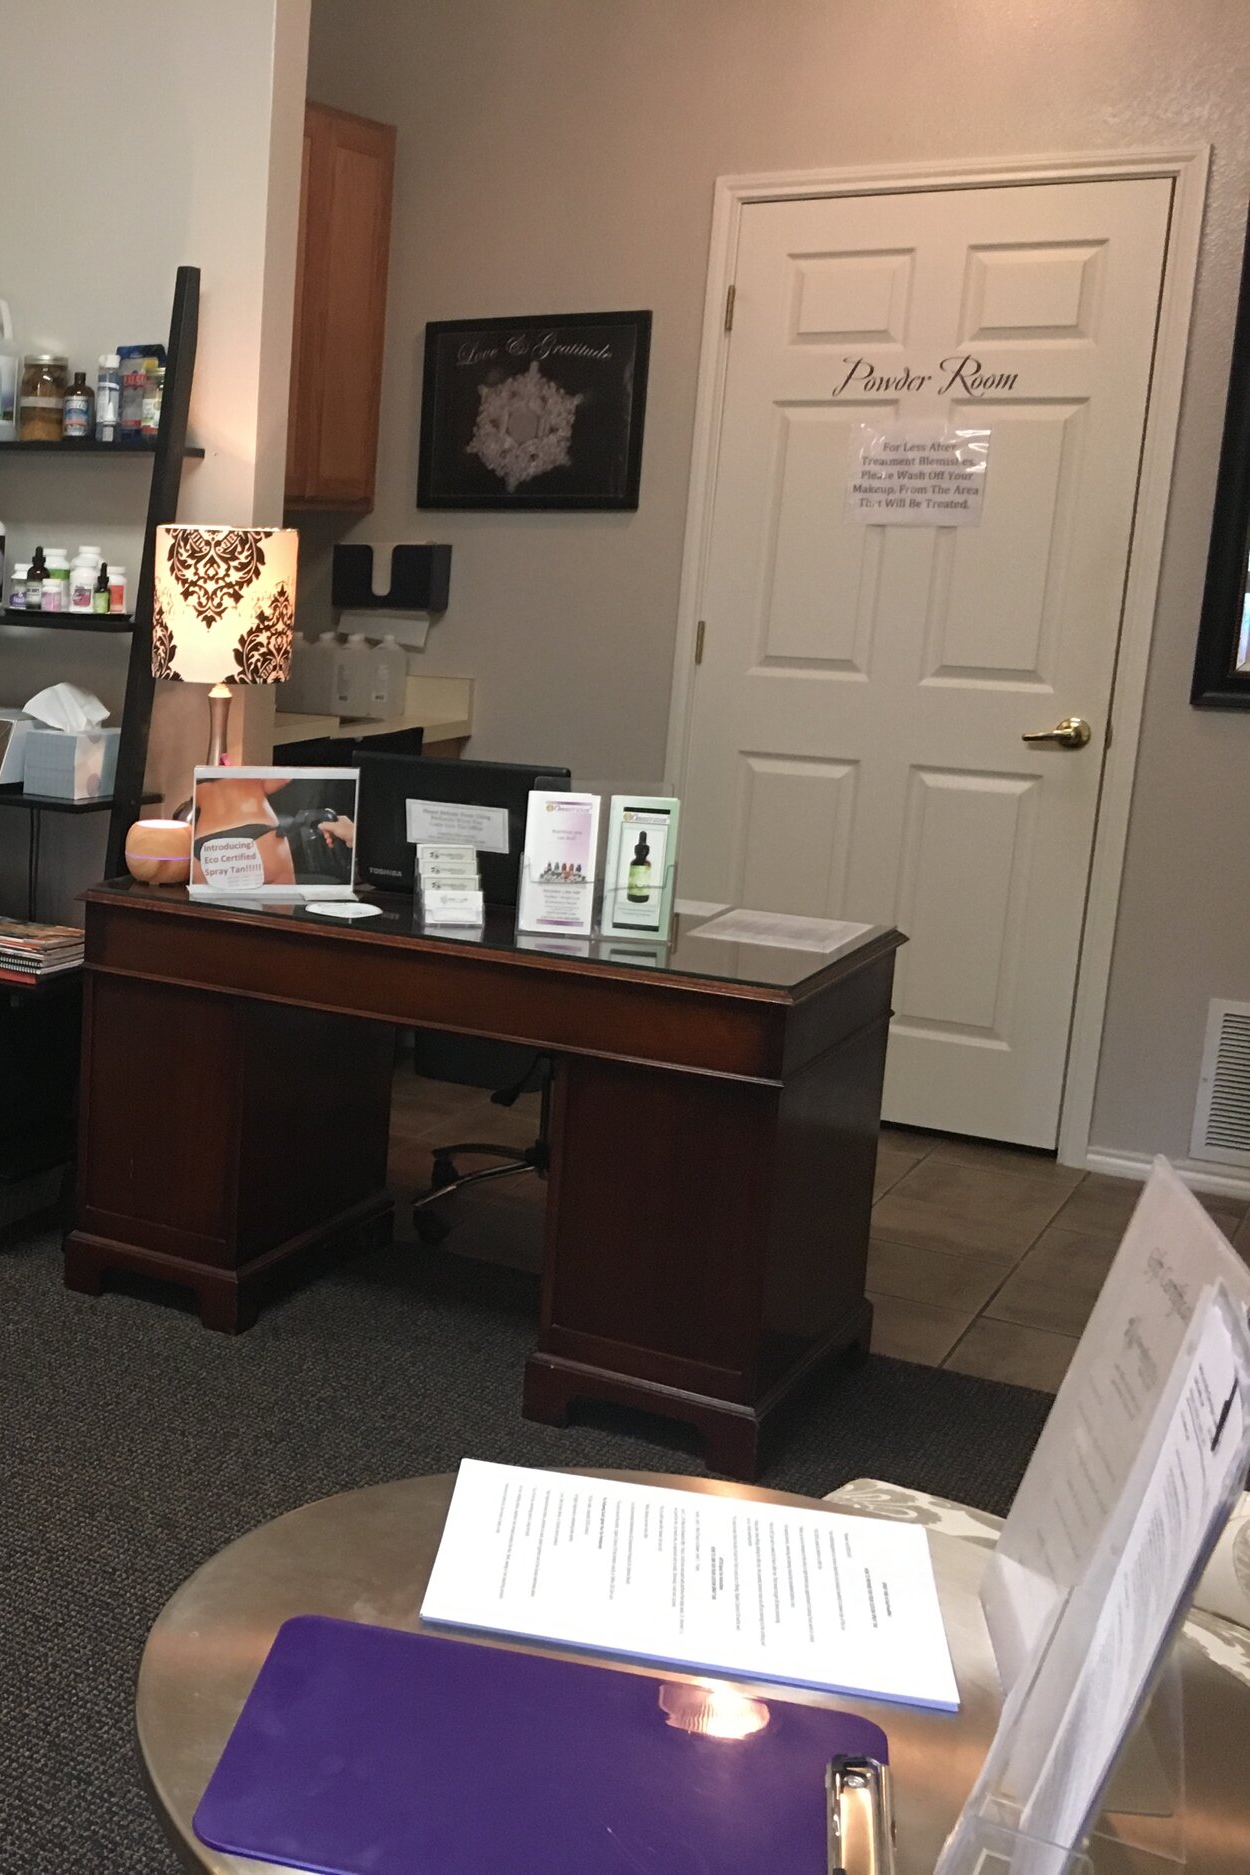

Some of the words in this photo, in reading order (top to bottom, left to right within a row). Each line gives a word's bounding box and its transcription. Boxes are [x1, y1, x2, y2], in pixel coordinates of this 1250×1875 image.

[456, 341, 499, 366] Love
[531, 331, 613, 360] Gratitude
[832, 356, 932, 397] Powder
[938, 354, 1019, 397] Room
[883, 442, 902, 452] For
[903, 442, 926, 452] Less
[860, 470, 894, 481] Pleae
[896, 471, 926, 481] Wash
[928, 471, 946, 481] Off
[947, 472, 974, 481] Your
[898, 485, 927, 495] From
[931, 485, 951, 495] The
[953, 485, 979, 496] Area
[859, 498, 882, 509] Tht
[885, 498, 906, 508] Will
[908, 498, 922, 509] Be
[204, 857, 219, 865] Eco
[220, 852, 256, 863] Certified
[204, 868, 229, 877] Spray
[368, 866, 403, 877] TOSHIBA
